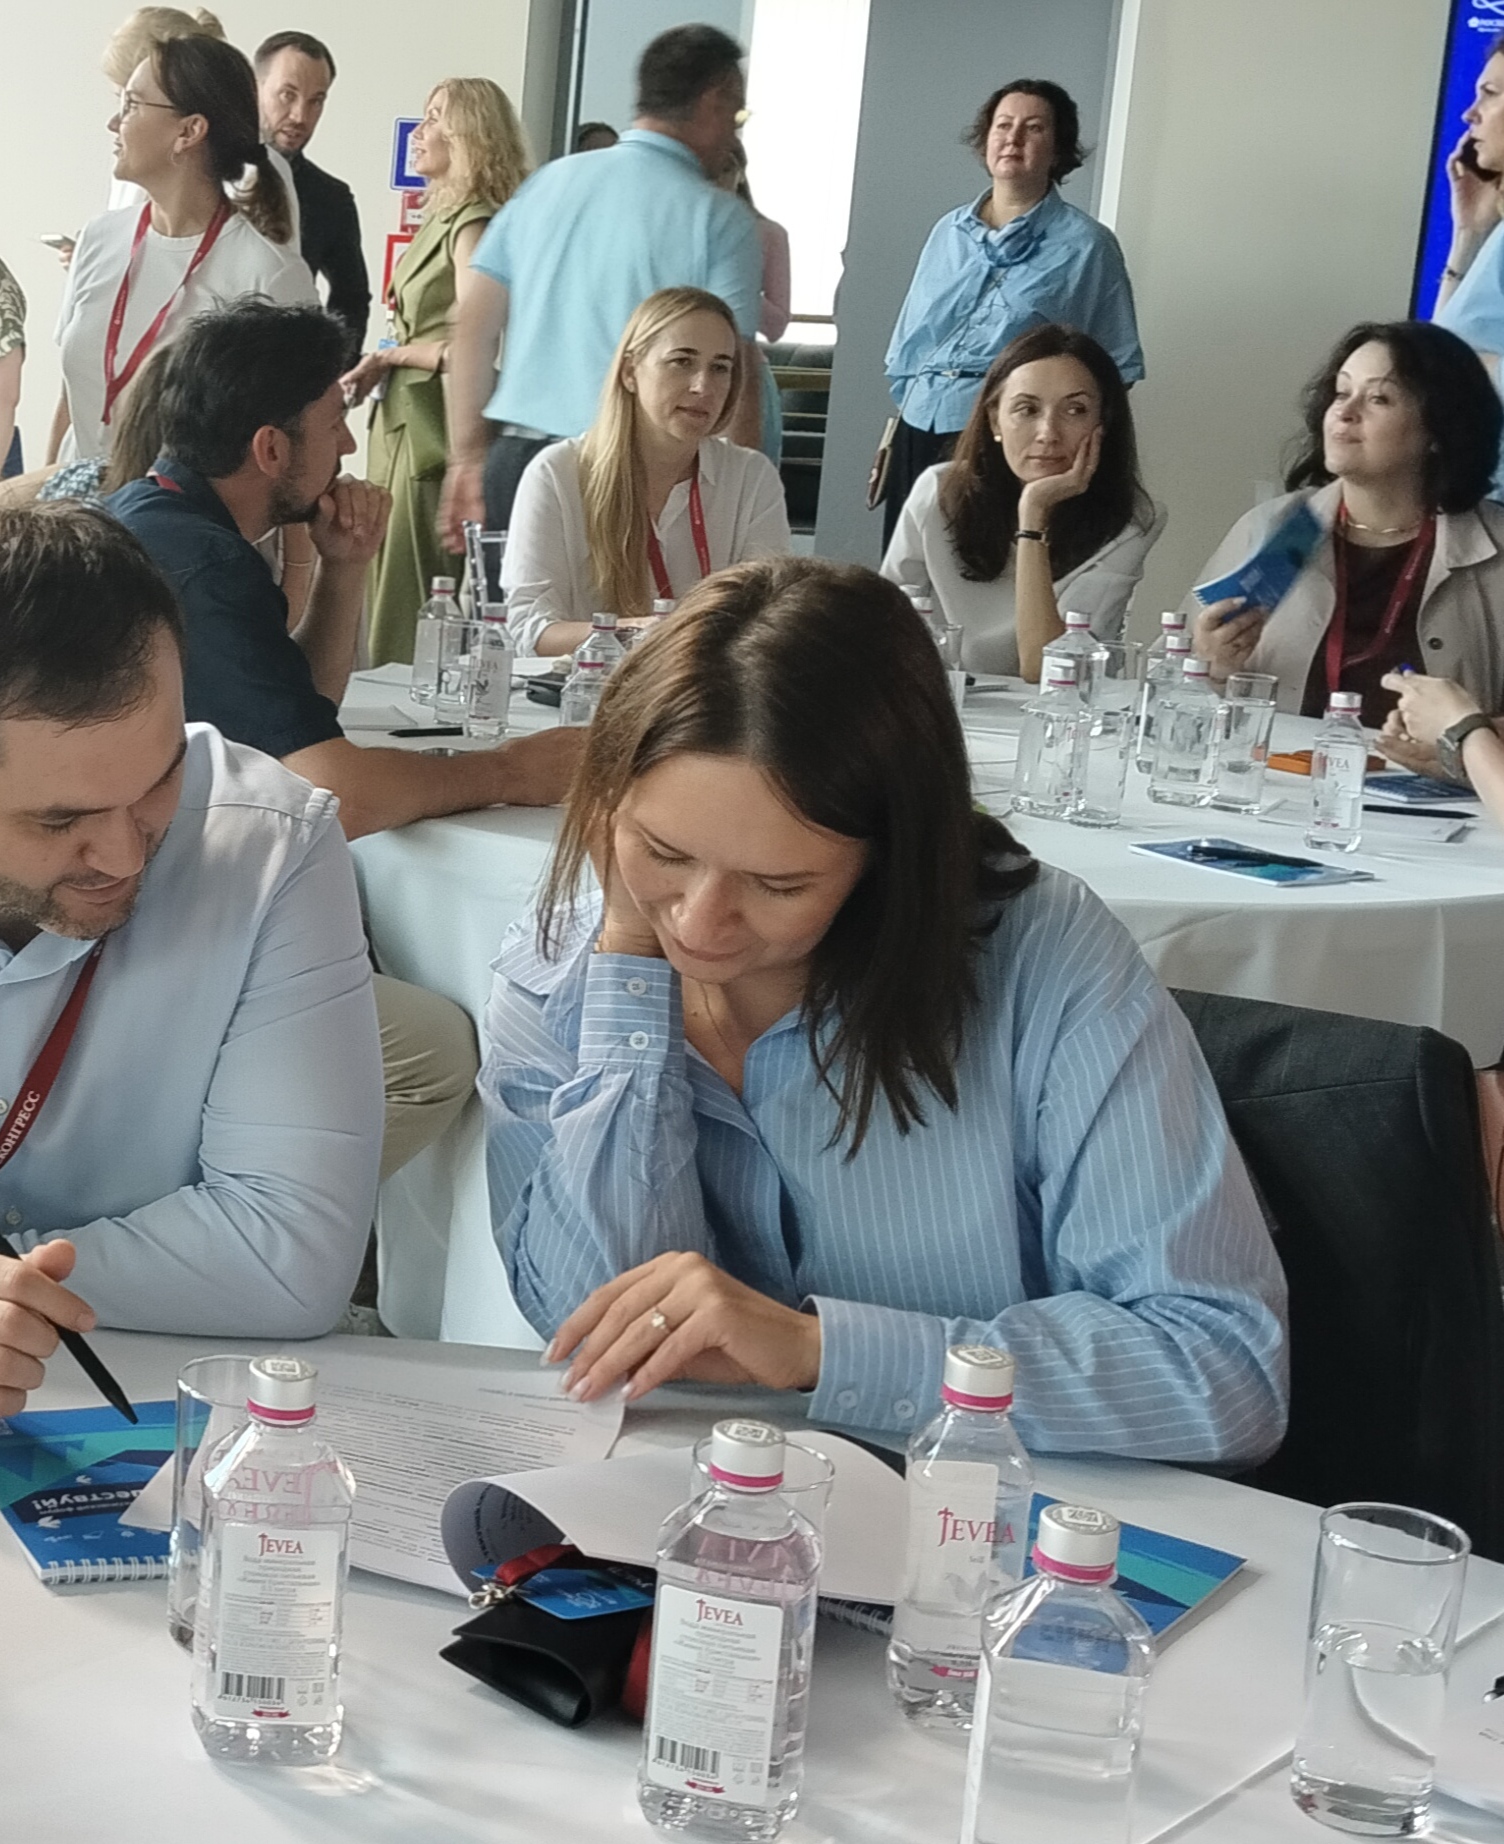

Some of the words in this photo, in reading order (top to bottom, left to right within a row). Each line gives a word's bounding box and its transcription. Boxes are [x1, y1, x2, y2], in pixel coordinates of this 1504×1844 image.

[937, 1506, 1016, 1547] JEVEA
[258, 1533, 303, 1556] JEVEA
[695, 1598, 744, 1626] JEVEA
